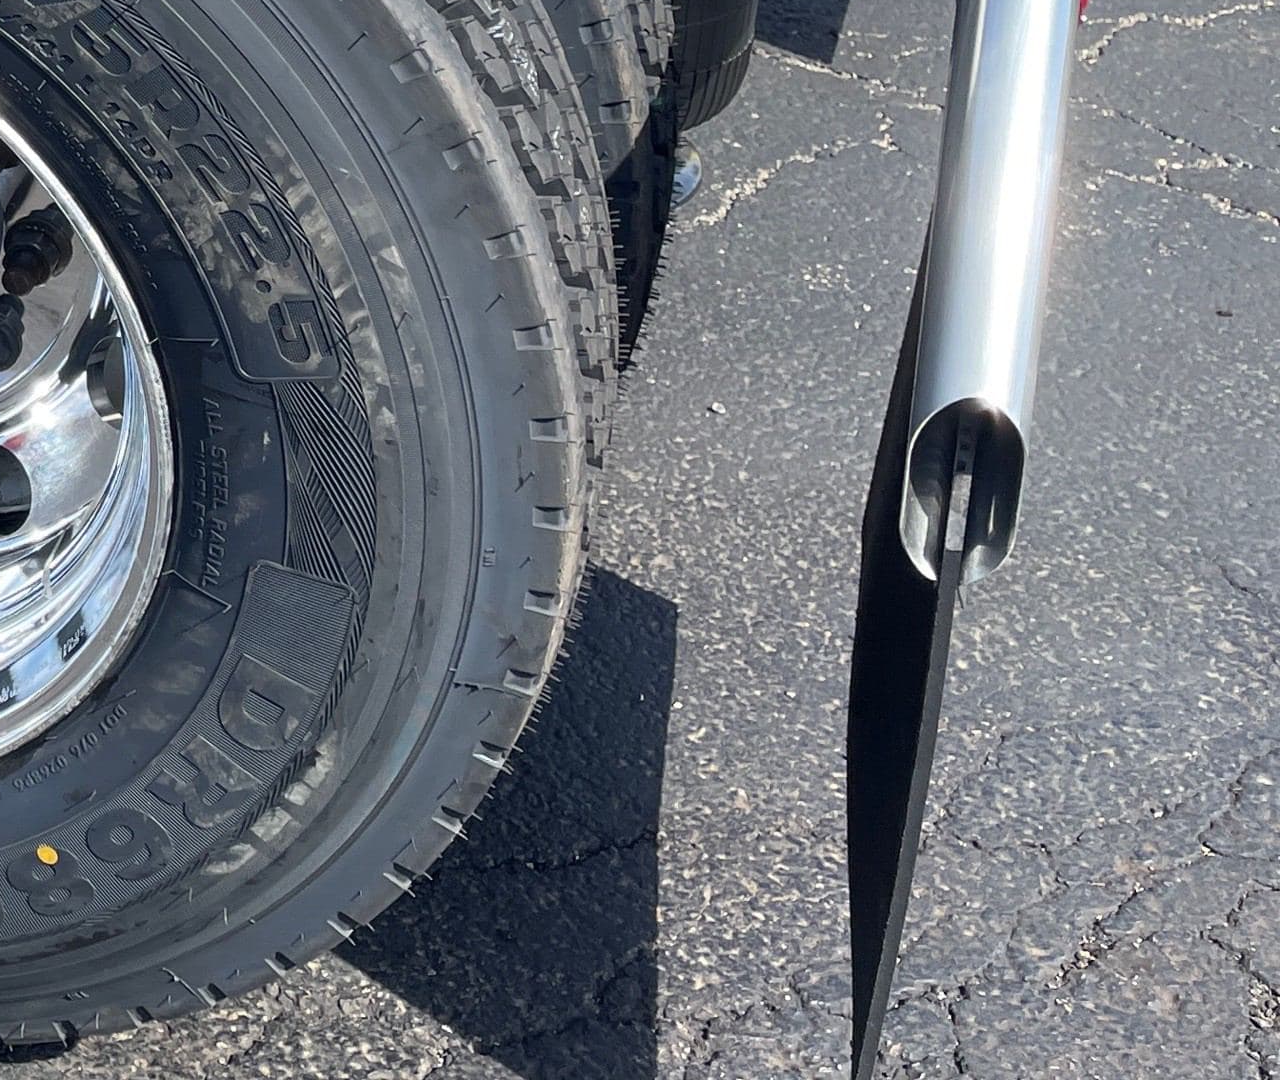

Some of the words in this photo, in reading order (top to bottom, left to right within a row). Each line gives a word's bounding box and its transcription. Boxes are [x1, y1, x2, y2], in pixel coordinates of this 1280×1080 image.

[202, 397, 224, 438] ALL
[207, 444, 230, 511] STEEL
[199, 517, 229, 589] RADIAL
